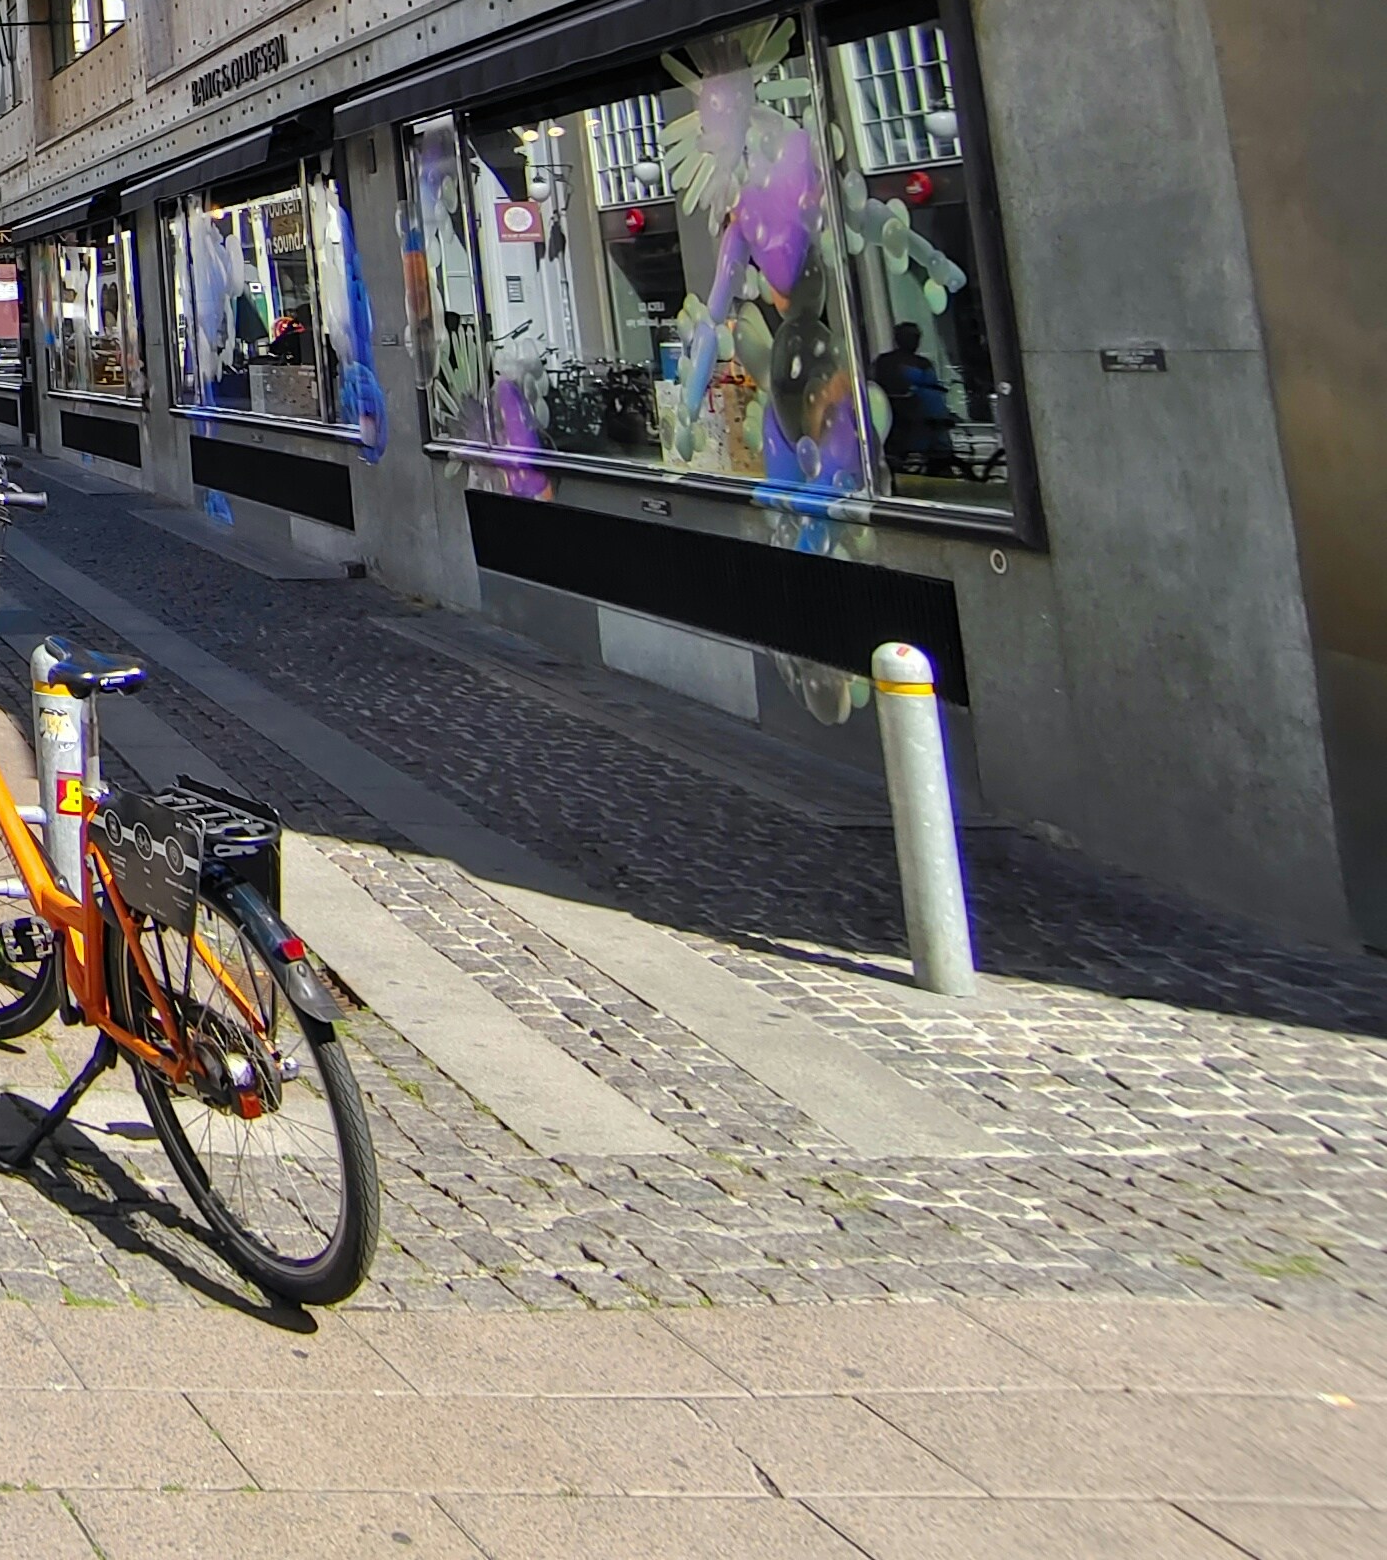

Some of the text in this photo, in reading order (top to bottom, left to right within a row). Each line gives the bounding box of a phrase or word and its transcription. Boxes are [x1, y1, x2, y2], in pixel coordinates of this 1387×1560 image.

[191, 68, 222, 107] BANG
[231, 33, 288, 90] OLUFSEN
[272, 221, 304, 255] sound.
